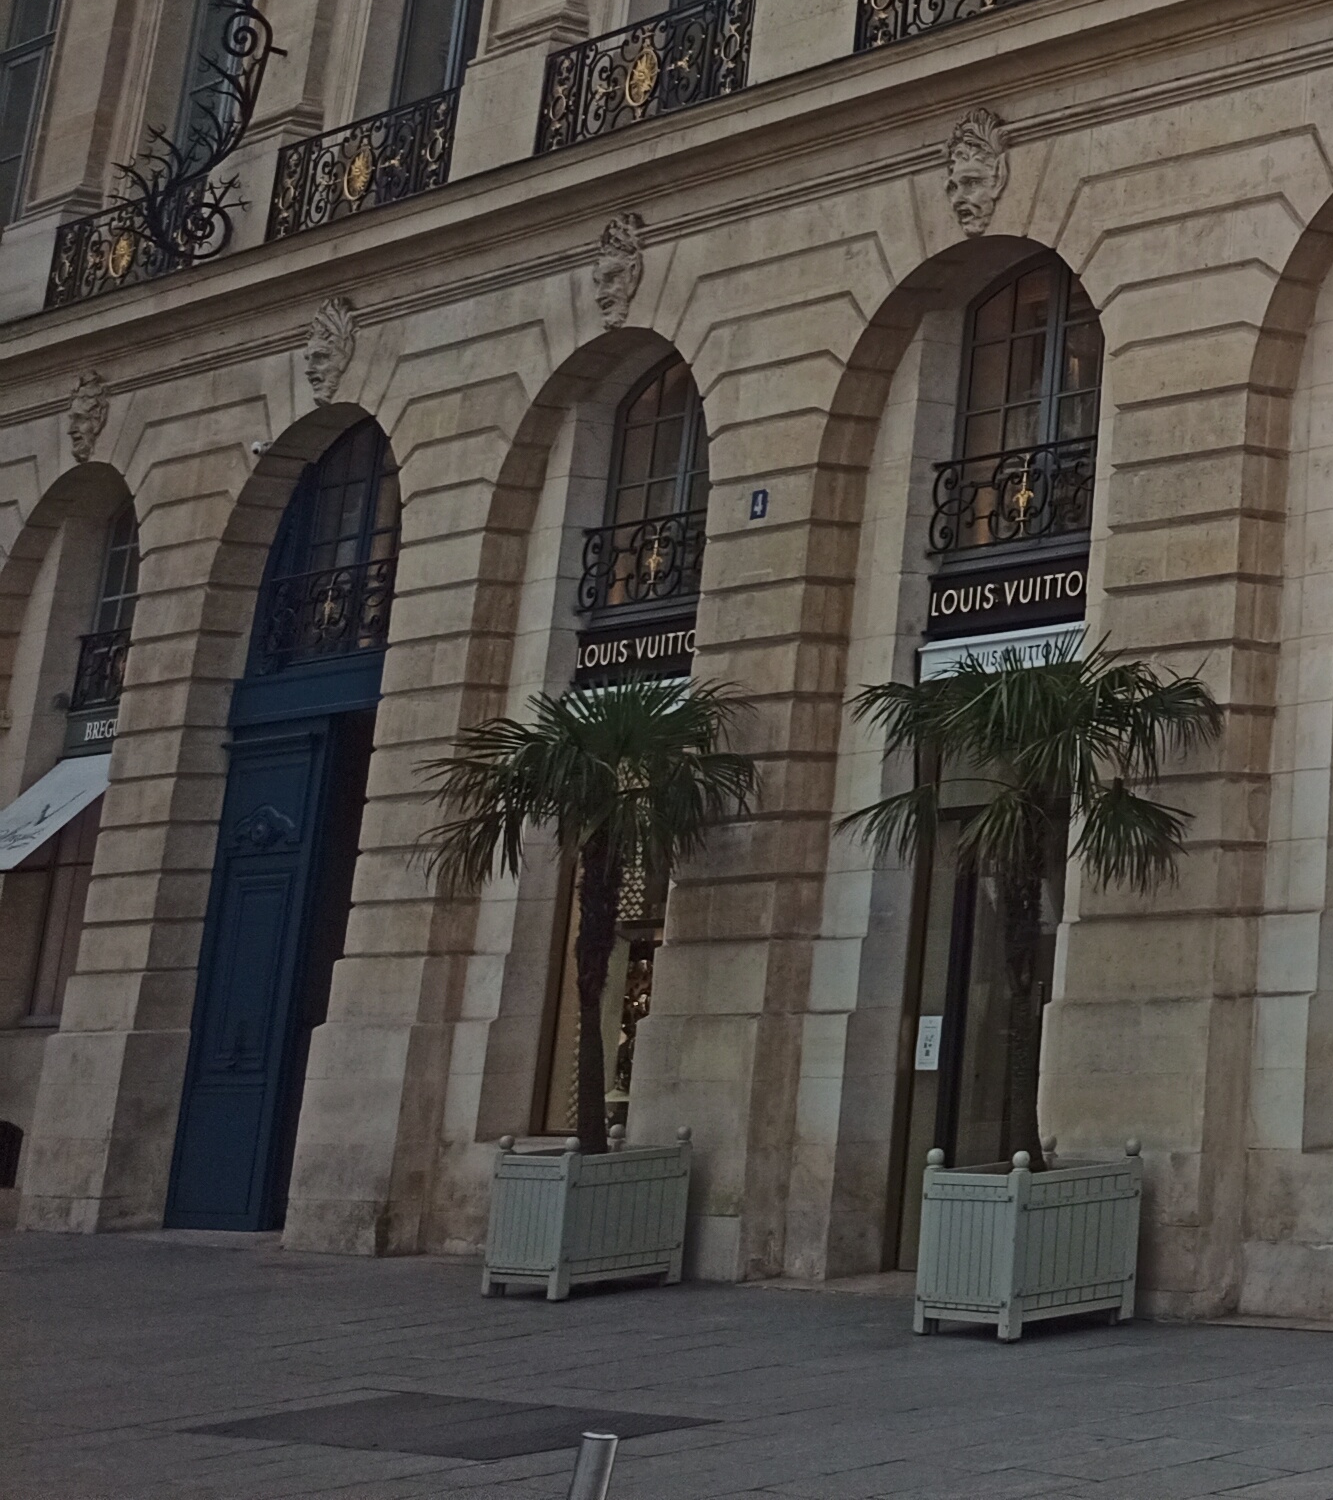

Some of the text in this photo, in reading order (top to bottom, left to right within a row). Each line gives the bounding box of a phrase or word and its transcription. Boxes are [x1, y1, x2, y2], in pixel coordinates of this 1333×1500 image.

[754, 493, 763, 515] 4
[931, 583, 995, 616] LOUIS
[577, 640, 628, 668] LOUIS
